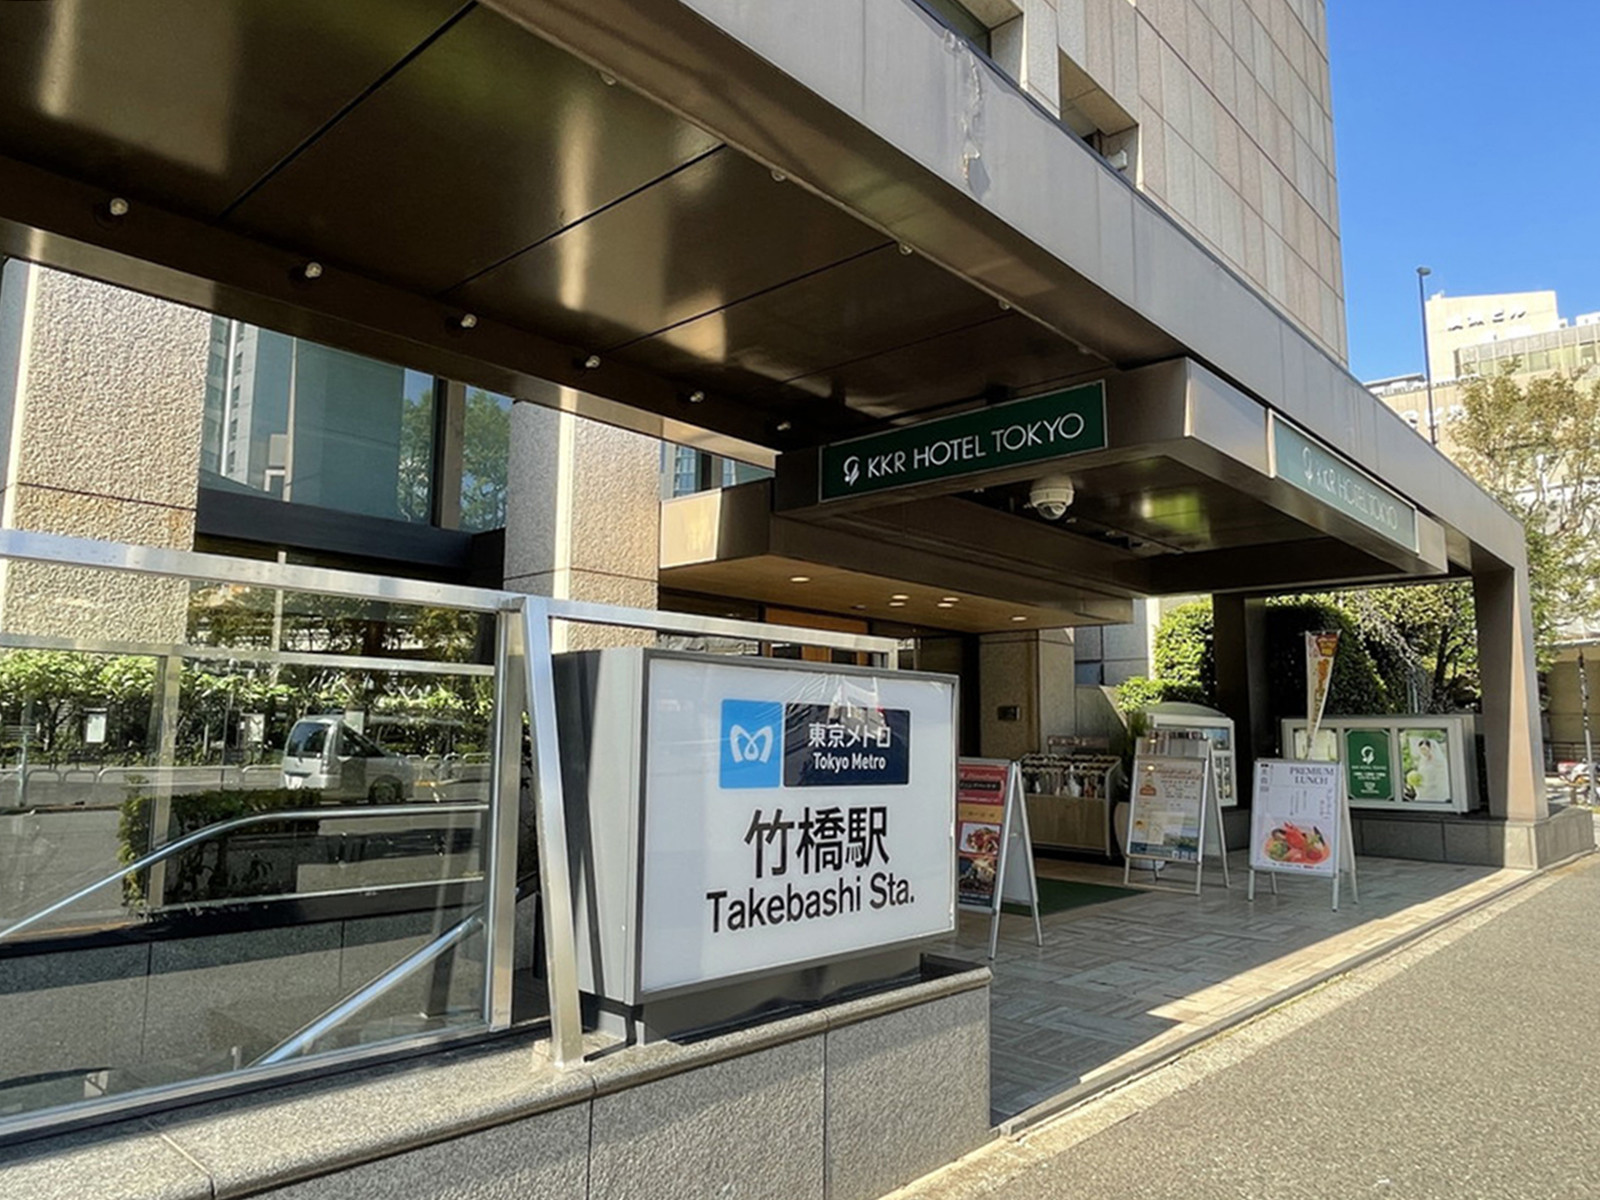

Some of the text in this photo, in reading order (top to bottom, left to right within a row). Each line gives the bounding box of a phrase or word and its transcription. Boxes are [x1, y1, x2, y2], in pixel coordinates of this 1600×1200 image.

[867, 412, 1085, 478] KKR HOTEL TOKYO
[808, 721, 891, 748] 東京メトロ
[813, 752, 887, 774] Tokyo Metro
[1289, 767, 1334, 776] PREMIUM
[1294, 776, 1329, 786] LUNCH
[744, 806, 890, 879] 竹橋駅
[706, 871, 915, 933] Takebashi Sta.
